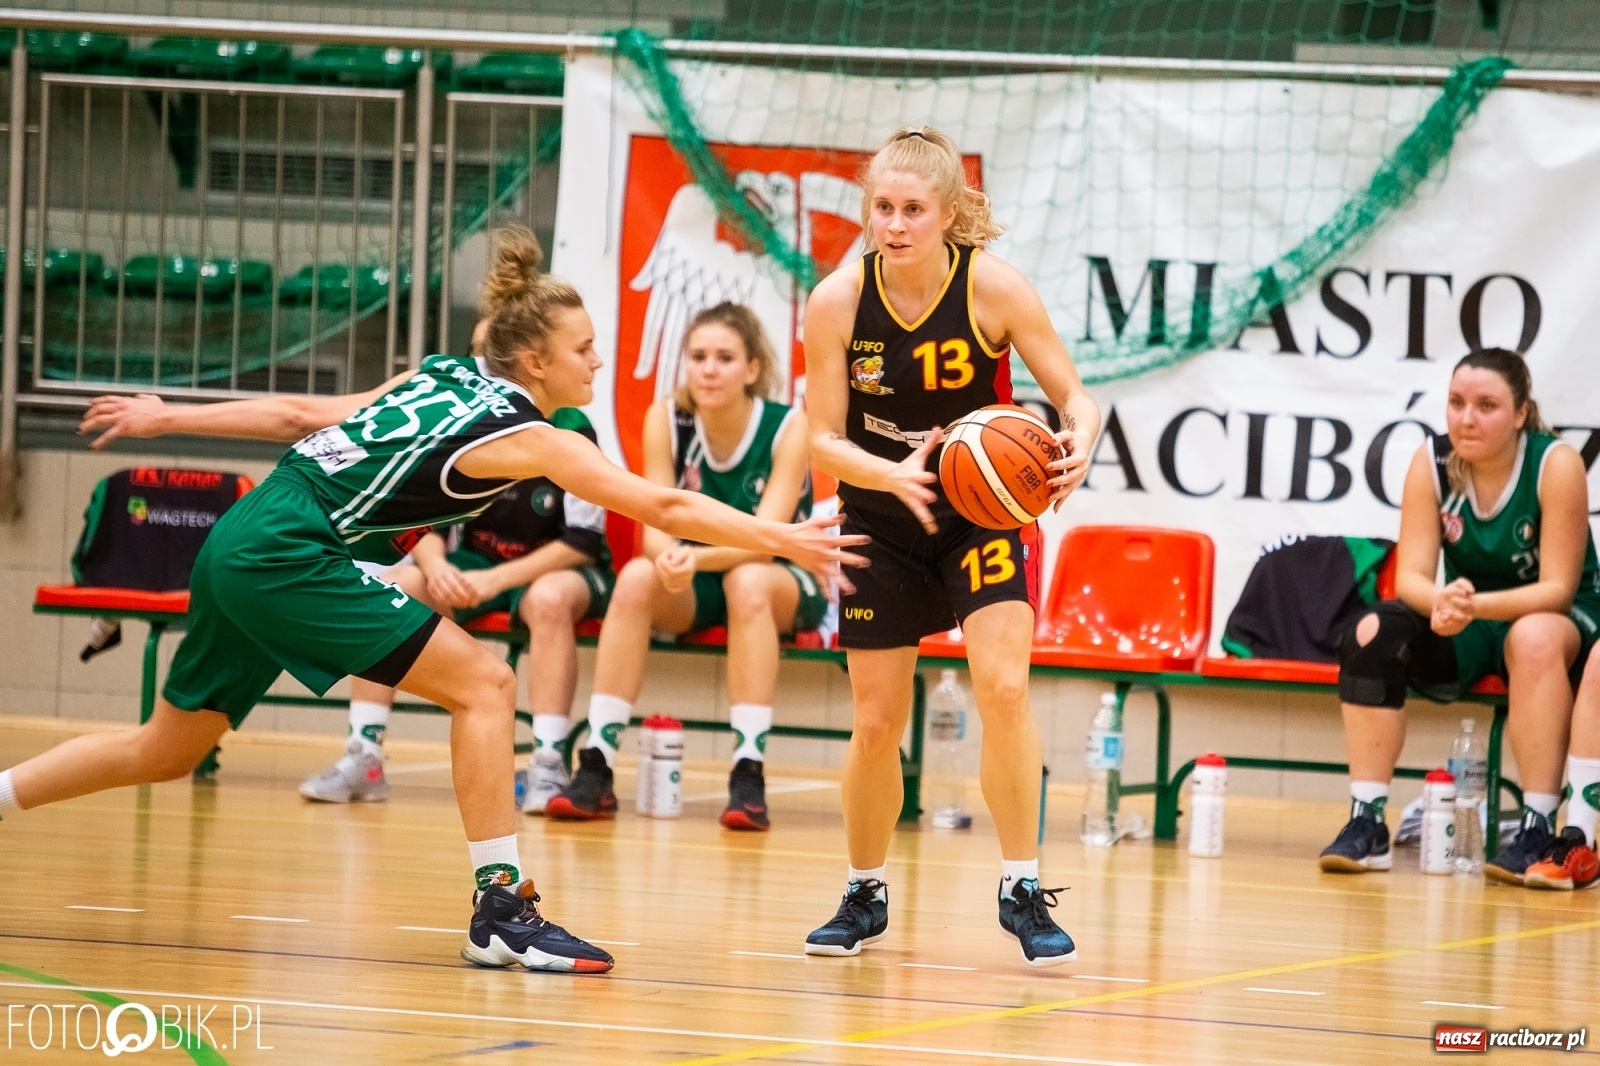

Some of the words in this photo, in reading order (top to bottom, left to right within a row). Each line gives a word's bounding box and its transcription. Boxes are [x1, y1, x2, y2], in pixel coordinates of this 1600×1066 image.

[1082, 254, 1542, 361] MIASTO
[912, 338, 975, 391] 13
[1023, 427, 1060, 470] molt
[1020, 465, 1042, 491] FIBA
[960, 538, 1016, 593] 13
[1511, 547, 1540, 581] 2
